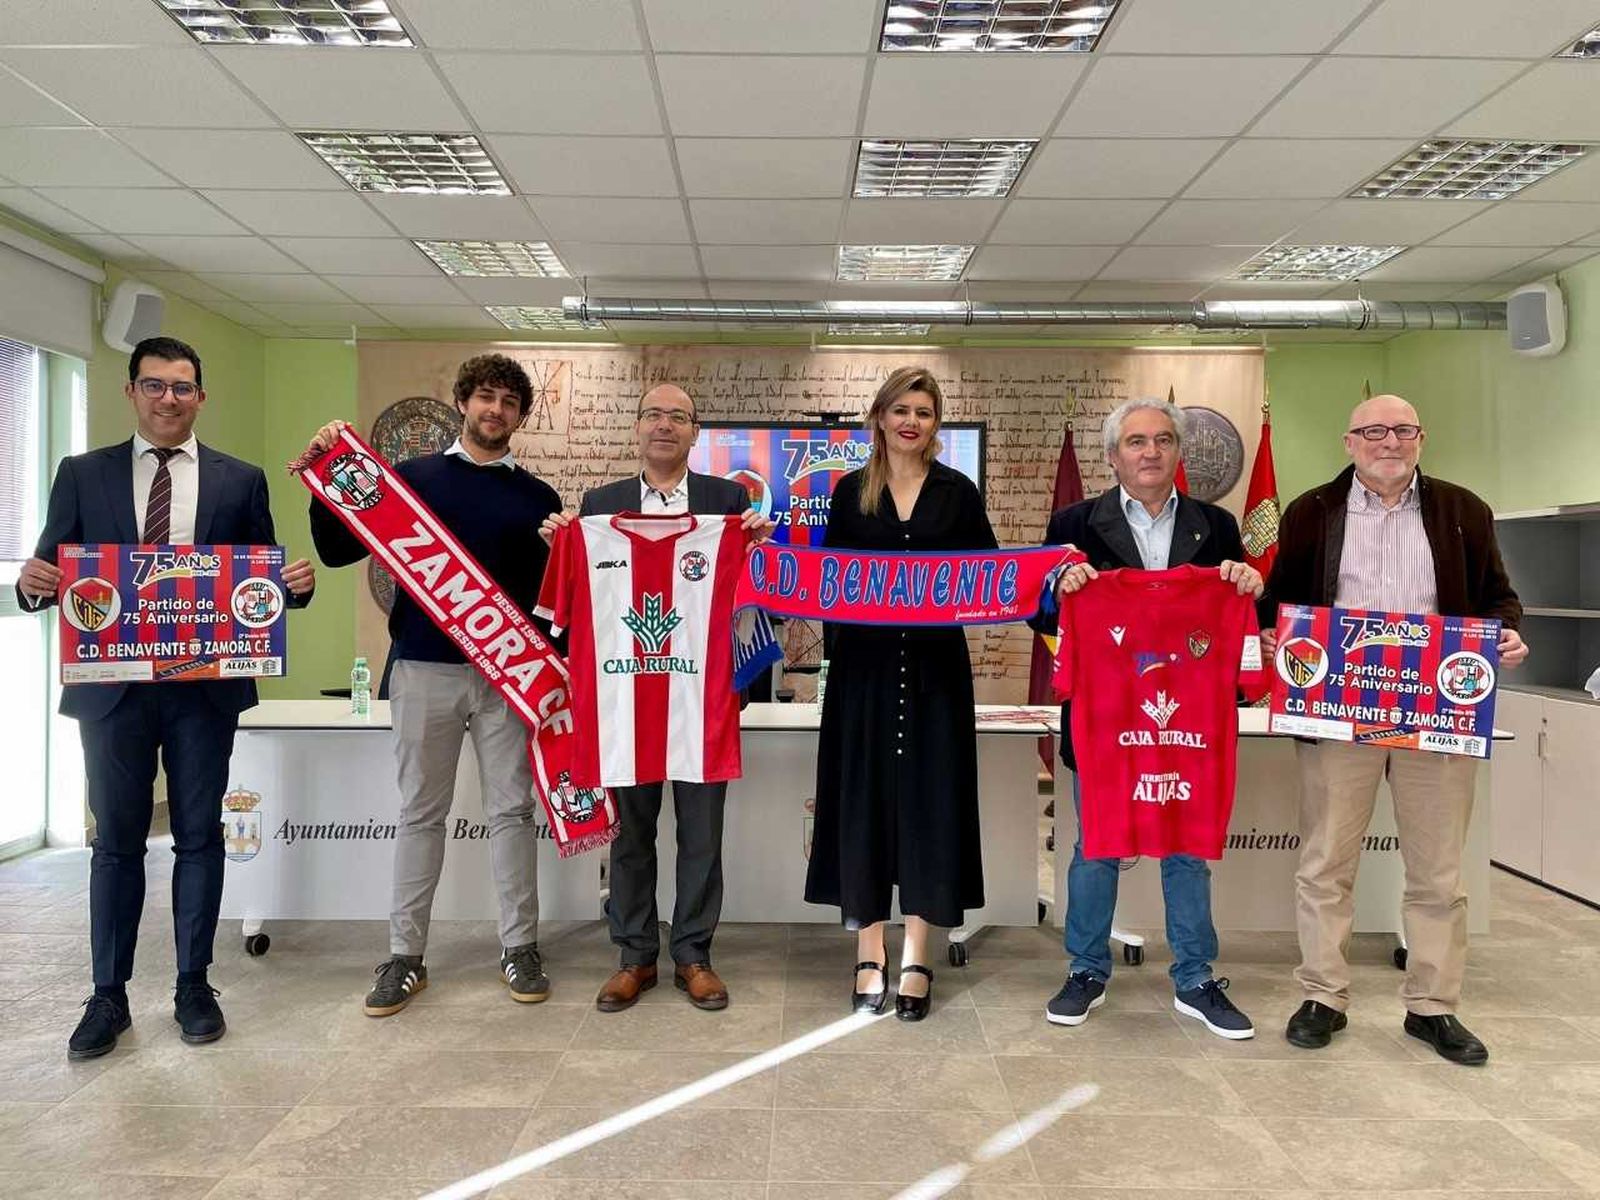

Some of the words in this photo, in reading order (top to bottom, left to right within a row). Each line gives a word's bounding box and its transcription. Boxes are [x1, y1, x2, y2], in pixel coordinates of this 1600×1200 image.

[782, 439, 831, 482] 75
[789, 497, 832, 510] Parti
[774, 512, 792, 526] 75
[130, 552, 175, 587] 75
[819, 555, 1018, 610] BENAVENTE
[138, 598, 192, 611] Partido
[196, 598, 215, 610] de
[123, 612, 141, 625] 75
[145, 611, 229, 625] Aniversario
[388, 521, 546, 694] ZAMORA
[537, 688, 574, 736] CF
[490, 591, 523, 627] DESDE
[520, 621, 547, 651] 1968
[1340, 616, 1384, 651] 75
[76, 643, 104, 659] C.D.
[107, 641, 186, 657] BENAVENTE
[204, 640, 252, 655] ZAMORA
[254, 639, 271, 654] C.F.
[447, 624, 480, 658] DESDE
[475, 652, 501, 681] 1968
[603, 658, 641, 674] CAJA
[644, 656, 698, 675] RURAL
[1344, 662, 1397, 679] Partido
[1401, 666, 1420, 681] de
[1329, 674, 1346, 687] 75
[1349, 674, 1433, 696] Aniversario
[1285, 698, 1308, 714] C.D.
[1312, 701, 1387, 722] BENAVENTE
[1405, 711, 1455, 731] ZAMORA
[1458, 716, 1476, 732] C.F.
[1118, 730, 1155, 747] CAJA
[1158, 730, 1207, 749] RURAL
[1132, 779, 1192, 806] ALIJAS
[274, 818, 398, 845] Ayuntamien
[1226, 827, 1301, 850] miento
